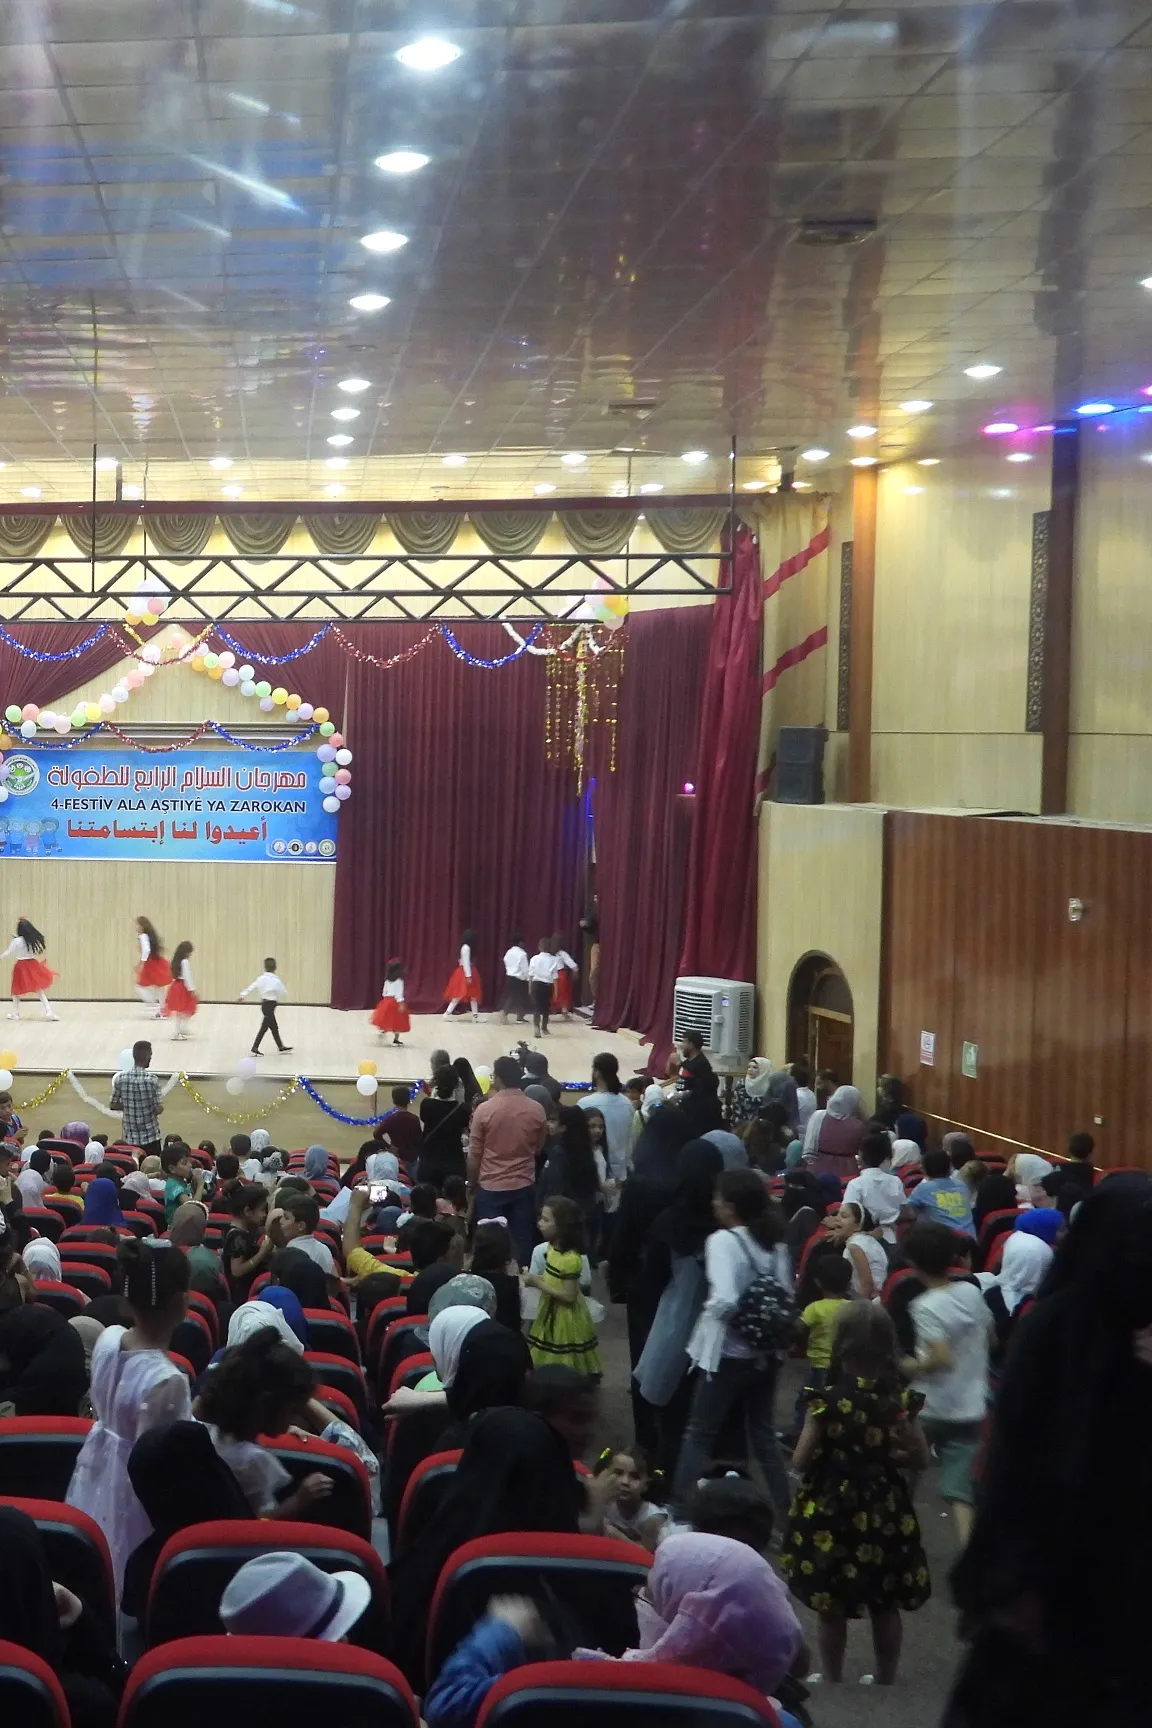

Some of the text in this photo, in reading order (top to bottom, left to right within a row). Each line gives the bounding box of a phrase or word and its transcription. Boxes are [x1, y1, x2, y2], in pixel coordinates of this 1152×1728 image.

[47, 765, 130, 791] للطفولة
[134, 765, 177, 792] الرابع
[180, 766, 231, 793] السلام
[235, 766, 307, 793] مهرجان
[117, 799, 147, 811] ALA
[150, 796, 203, 815] AŞTIYÊ
[206, 800, 226, 812] YA
[230, 800, 306, 813] ZAROKAN
[67, 815, 267, 845] أعيدوا لنا إبتسامتنا
